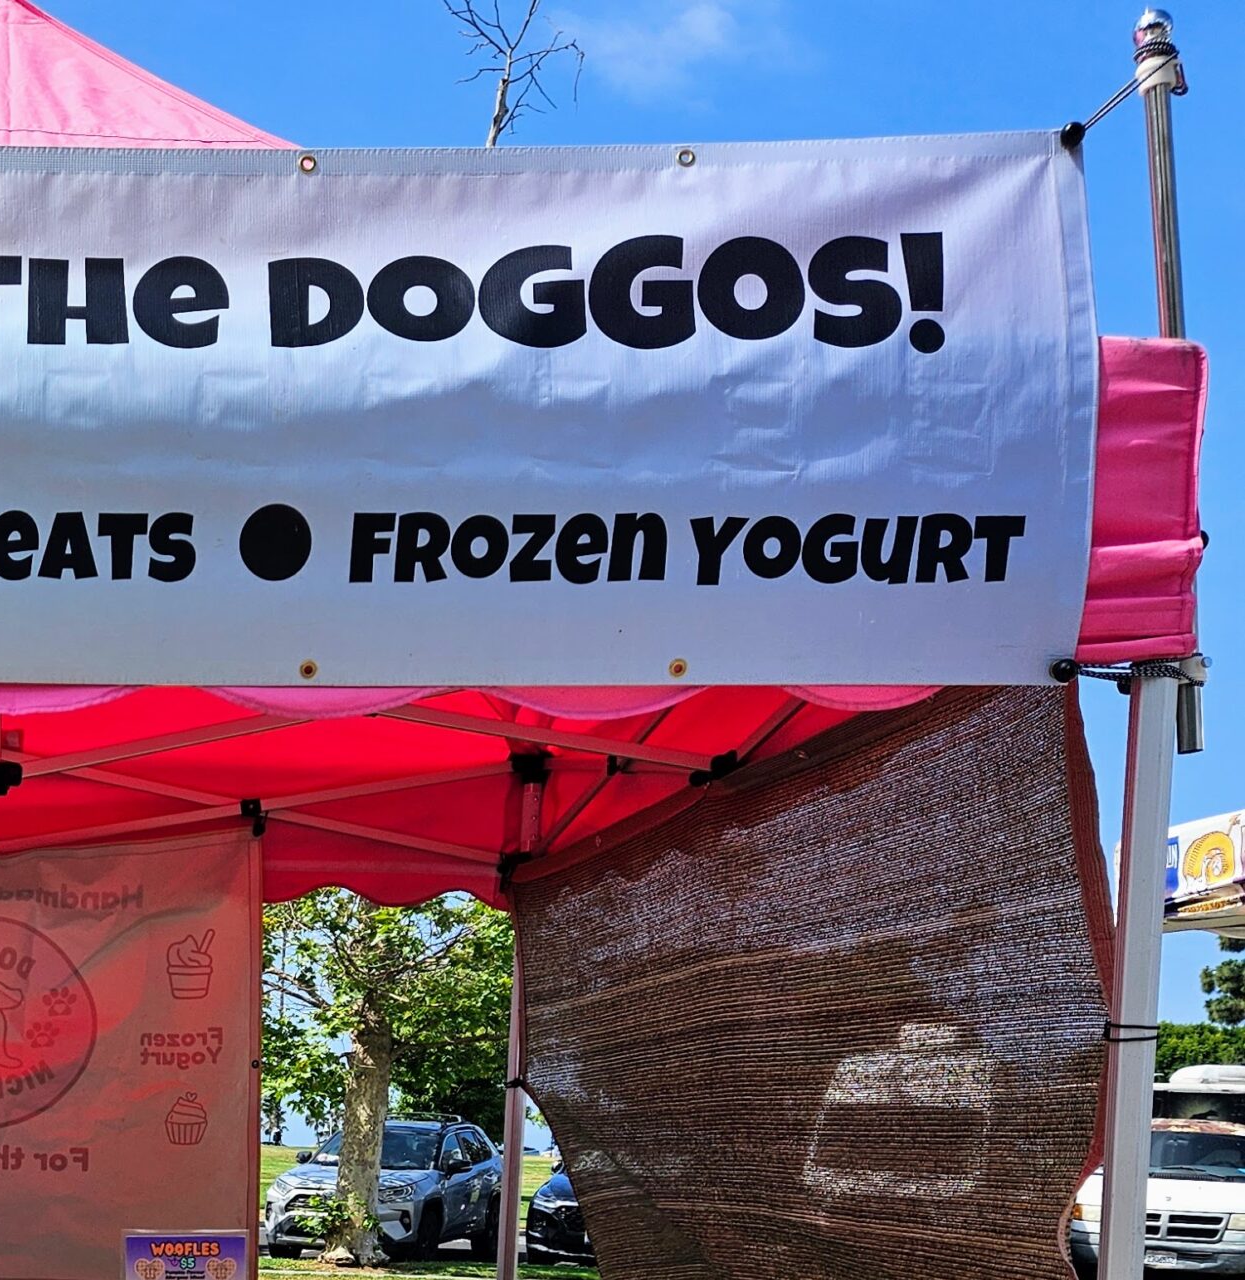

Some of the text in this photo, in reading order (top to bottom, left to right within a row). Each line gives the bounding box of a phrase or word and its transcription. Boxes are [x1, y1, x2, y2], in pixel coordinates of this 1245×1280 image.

[268, 232, 946, 354] DOGGOS!
[150, 1242, 220, 1257] WOOFLES
[180, 1256, 196, 1269] $5
